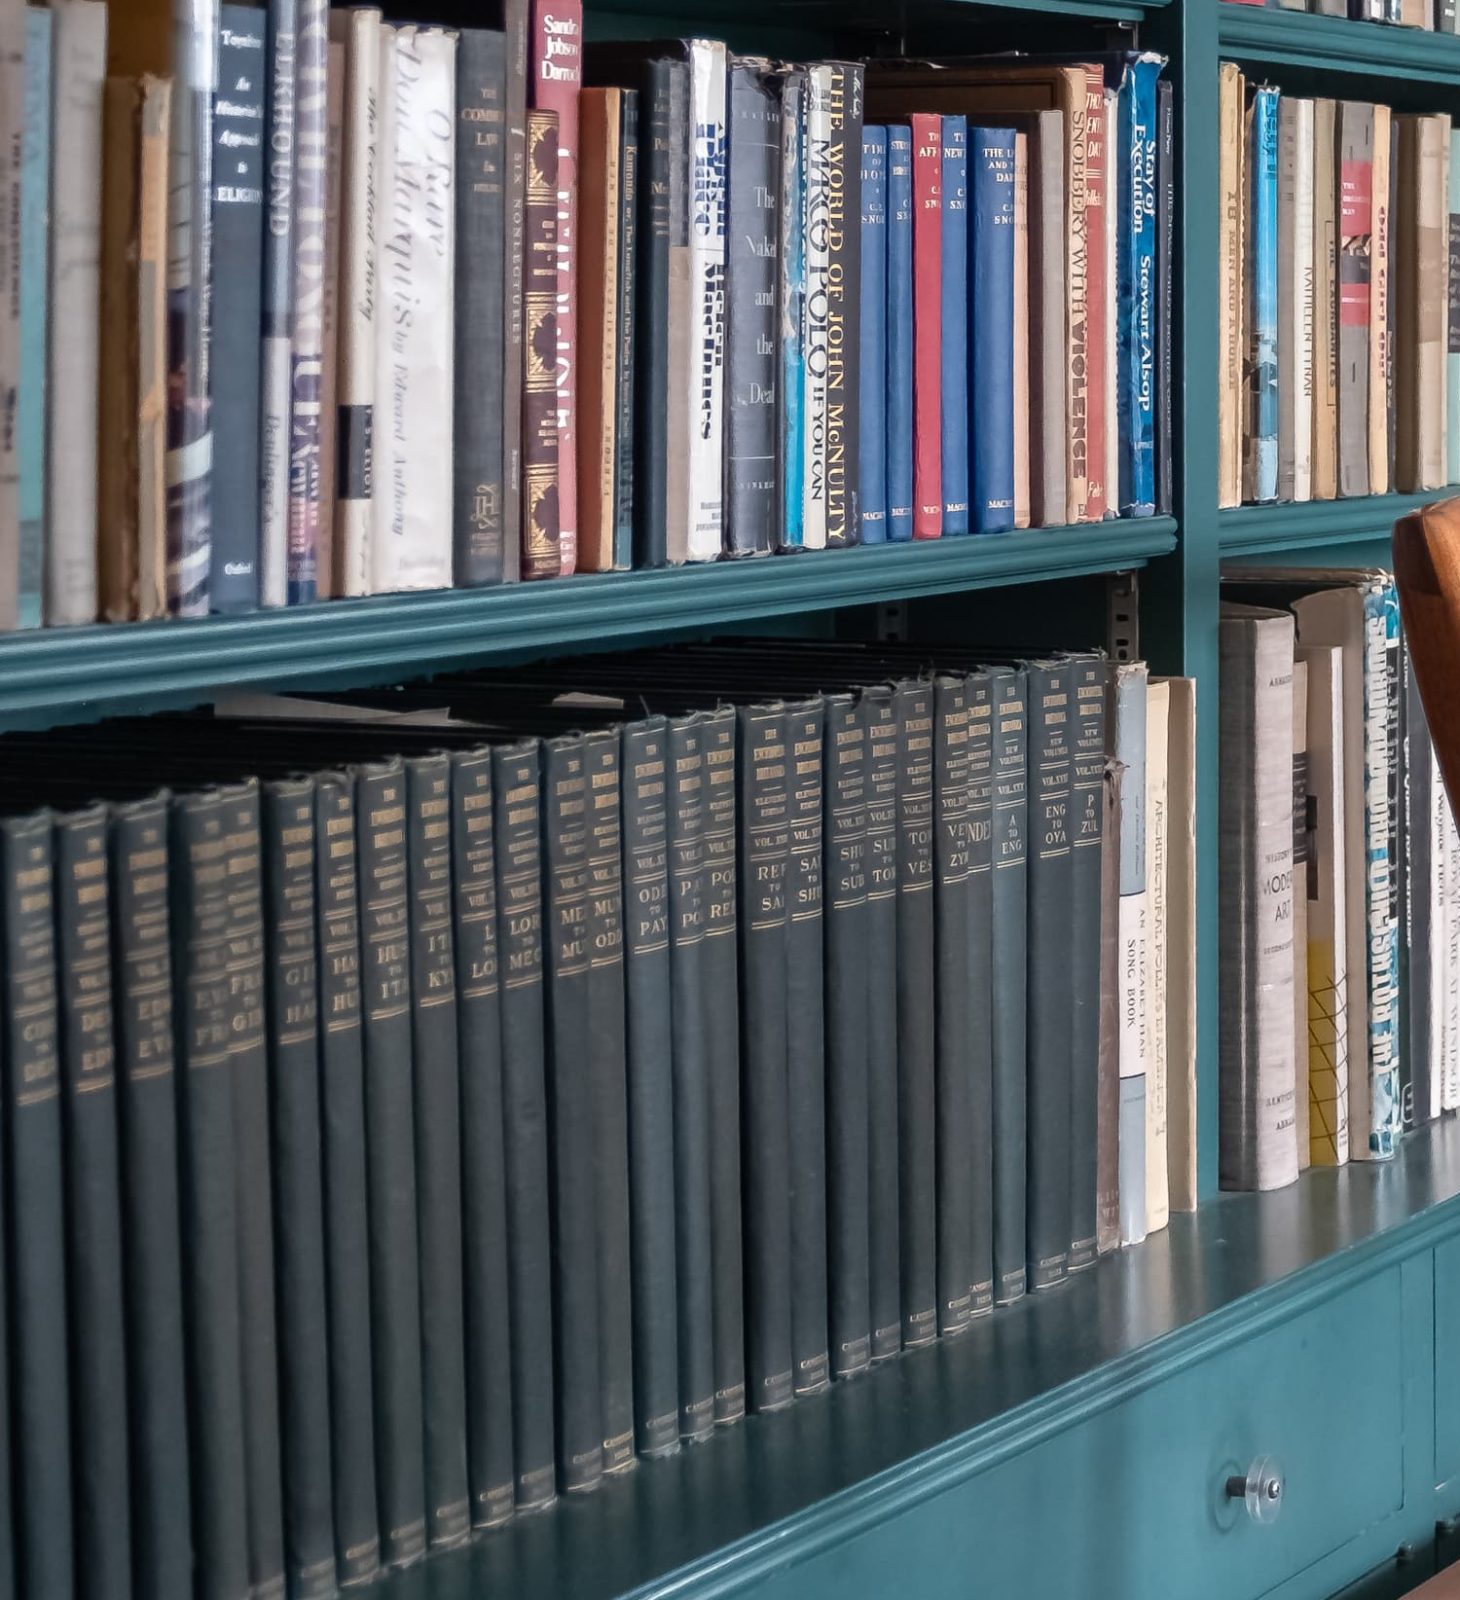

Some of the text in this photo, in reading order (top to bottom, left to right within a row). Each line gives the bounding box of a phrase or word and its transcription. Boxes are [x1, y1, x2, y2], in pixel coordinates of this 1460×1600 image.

[983, 148, 1004, 158] THE
[987, 161, 1007, 170] AND
[810, 138, 830, 253] MARCO
[1130, 124, 1146, 234] Execution
[1143, 140, 1156, 216] Stay of
[753, 186, 775, 209] The
[754, 284, 774, 307] and
[827, 68, 846, 542] THE WORLD OF JOHN McNULTY
[1071, 110, 1087, 480] SNOBBERY WITH VIOLENCE
[1228, 276, 1238, 312] AND
[756, 333, 774, 355] the
[1137, 255, 1152, 411] Stewart Alsop
[394, 363, 408, 442] Edward
[813, 387, 827, 407] IF
[813, 411, 828, 455] YOU
[391, 450, 408, 535] Anthony
[812, 459, 827, 500] CAN
[1008, 814, 1017, 827] A
[1045, 804, 1066, 817] ENG
[1052, 818, 1063, 829] TO
[1080, 819, 1099, 834] ZUL
[1002, 838, 1023, 855] ENG
[1045, 829, 1067, 845] OYA
[1154, 799, 1164, 939] ARCHITECTURAL
[1125, 938, 1137, 1028] SONG BOOK
